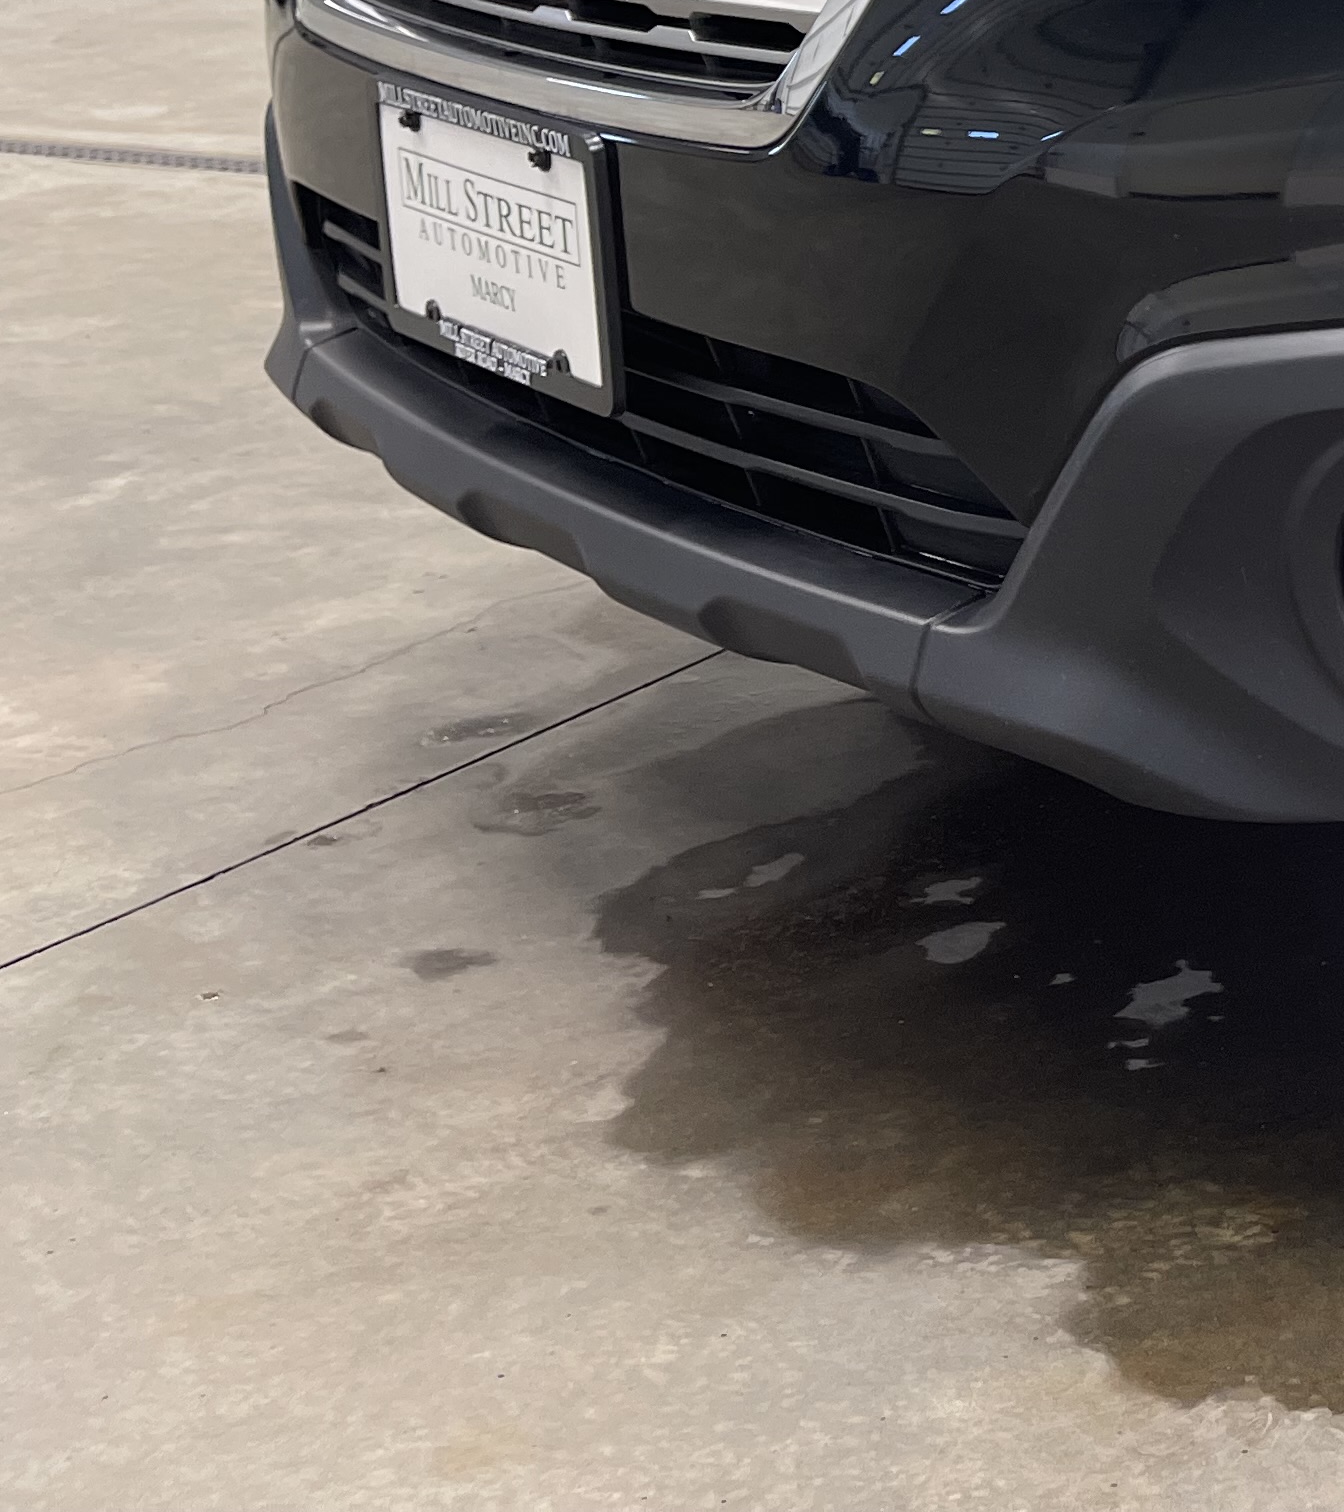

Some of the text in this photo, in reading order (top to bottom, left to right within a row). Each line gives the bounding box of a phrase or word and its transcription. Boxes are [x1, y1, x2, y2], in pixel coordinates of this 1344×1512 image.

[463, 178, 574, 255] STREET
[418, 217, 566, 290] AUTOMOTIVE
[470, 274, 517, 312] MARCY
